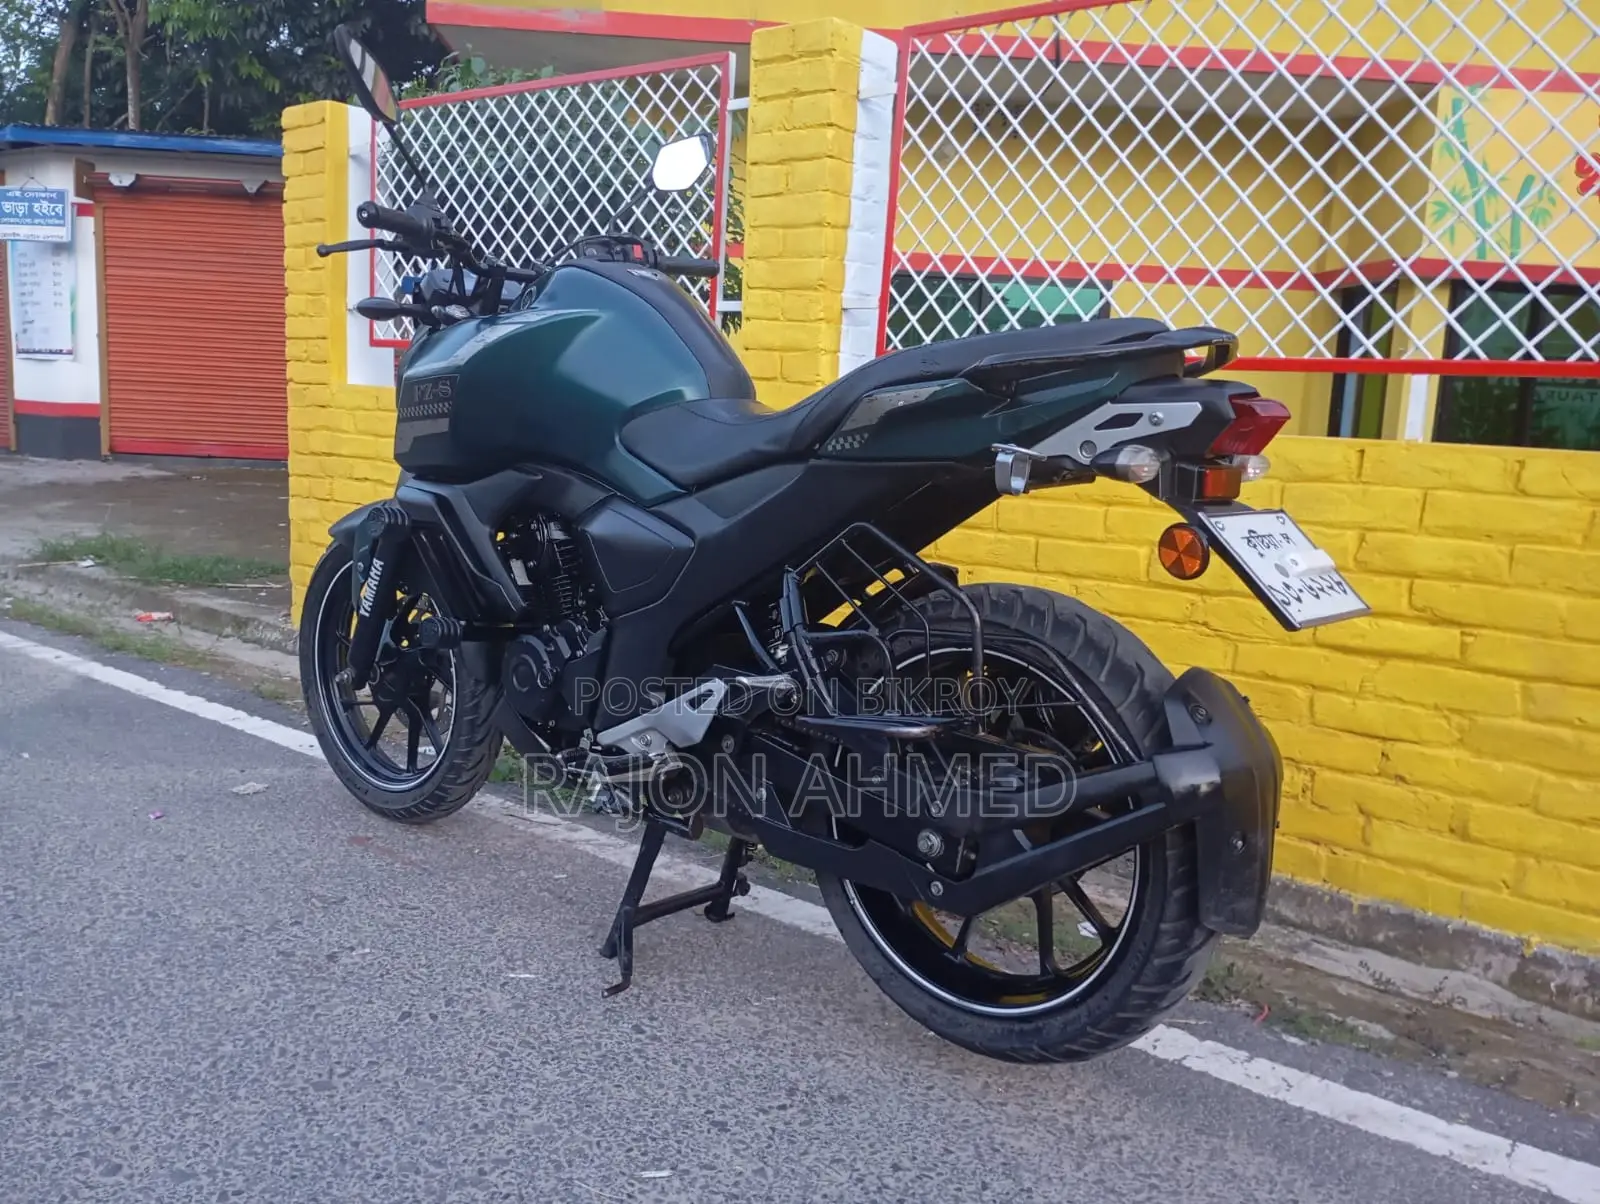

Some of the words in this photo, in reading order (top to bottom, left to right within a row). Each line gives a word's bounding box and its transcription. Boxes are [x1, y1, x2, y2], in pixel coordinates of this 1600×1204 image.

[1, 201, 28, 217] ভাড়া
[31, 199, 64, 217] হইবে
[360, 557, 384, 617] YAMAHA
